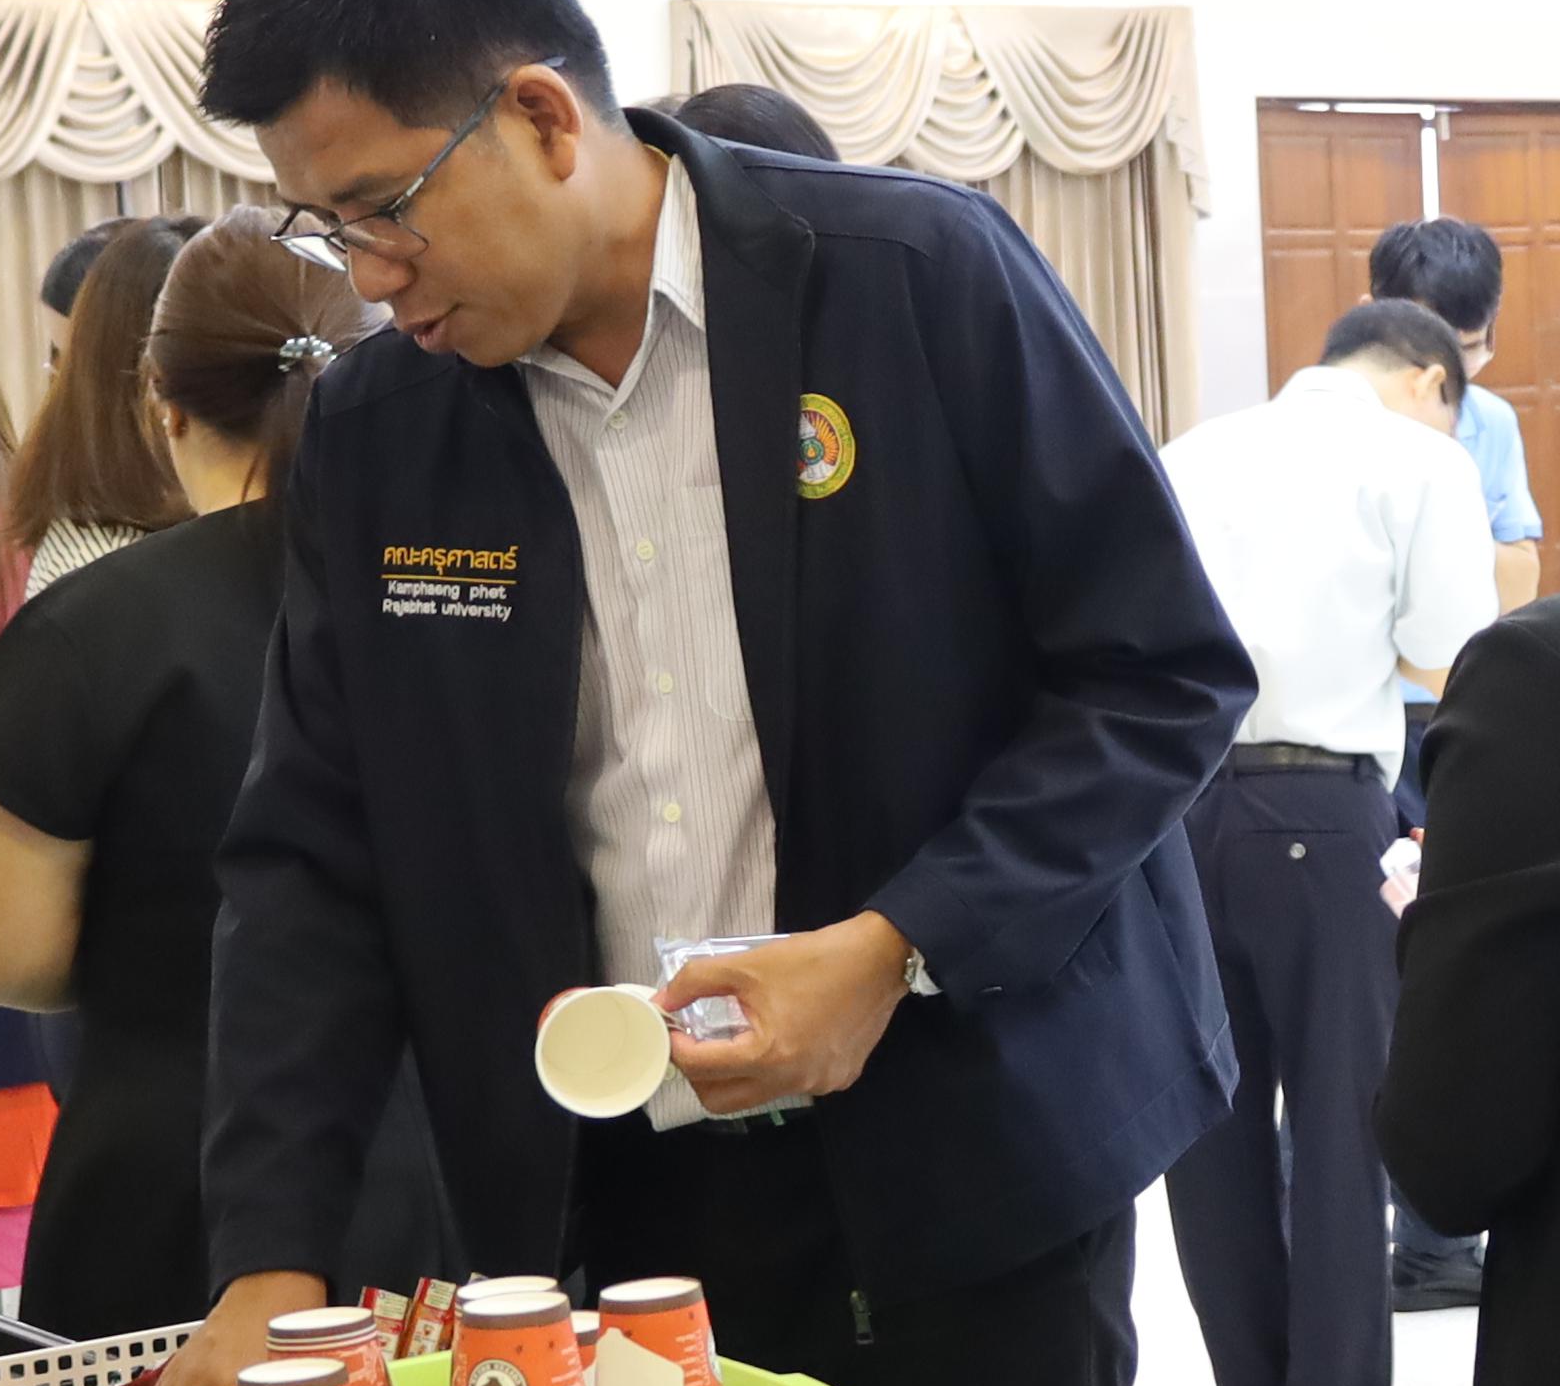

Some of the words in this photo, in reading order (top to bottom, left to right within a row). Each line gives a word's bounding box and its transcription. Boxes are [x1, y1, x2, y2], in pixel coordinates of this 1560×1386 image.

[383, 545, 519, 575] คณะครุศาสตร์
[441, 602, 512, 622] university
